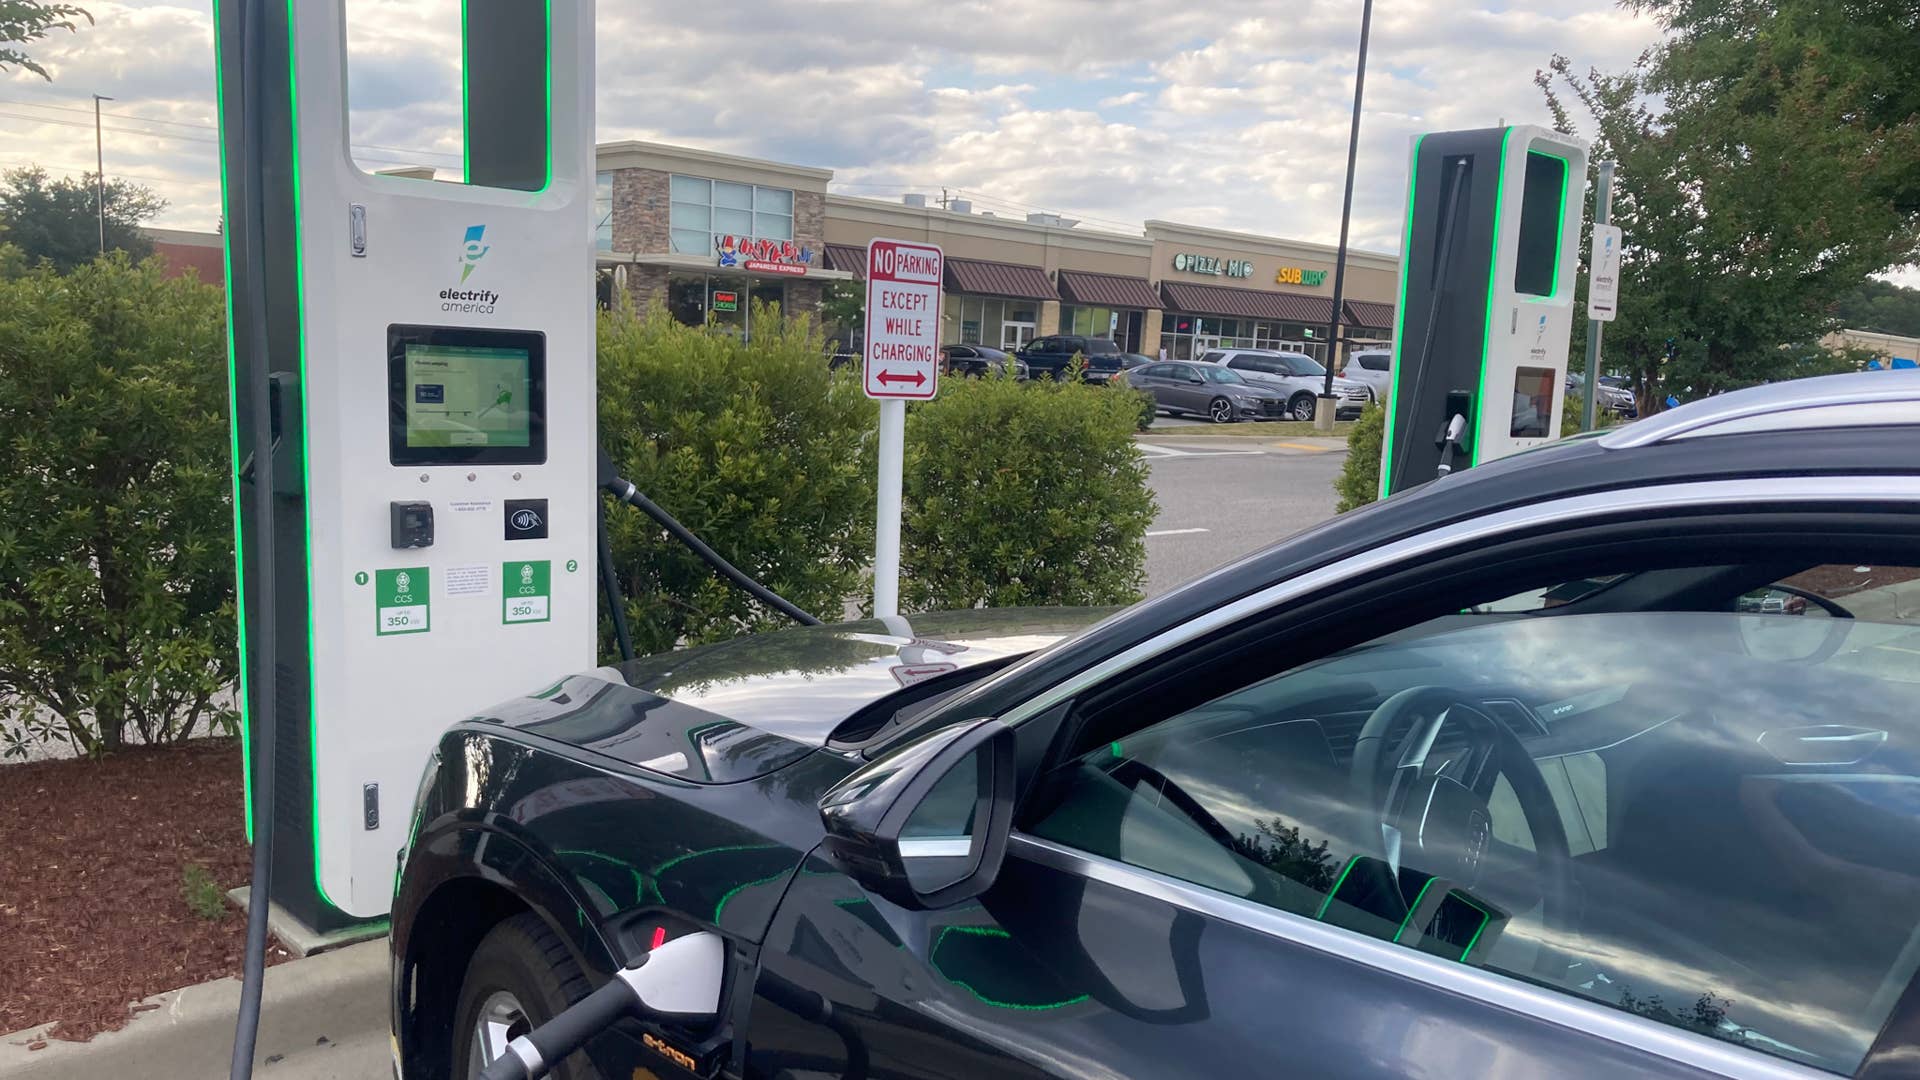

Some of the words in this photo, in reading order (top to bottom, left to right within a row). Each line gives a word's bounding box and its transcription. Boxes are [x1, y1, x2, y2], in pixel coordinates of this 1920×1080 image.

[748, 262, 777, 271] JAPANESE
[779, 265, 804, 273] EXPRESS
[874, 248, 894, 274] NO
[896, 253, 938, 276] PARKING
[1277, 267, 1326, 286] SUBWAY
[439, 288, 499, 304] electrify
[882, 291, 928, 311] EXCEPT
[441, 302, 494, 314] america
[886, 317, 922, 336] WHILE
[873, 342, 932, 362] CHARGING
[519, 586, 536, 594] CCS
[394, 594, 413, 604] CCS
[512, 606, 532, 616] 350
[387, 616, 409, 626] 350
[643, 1033, 695, 1072] e-tron
